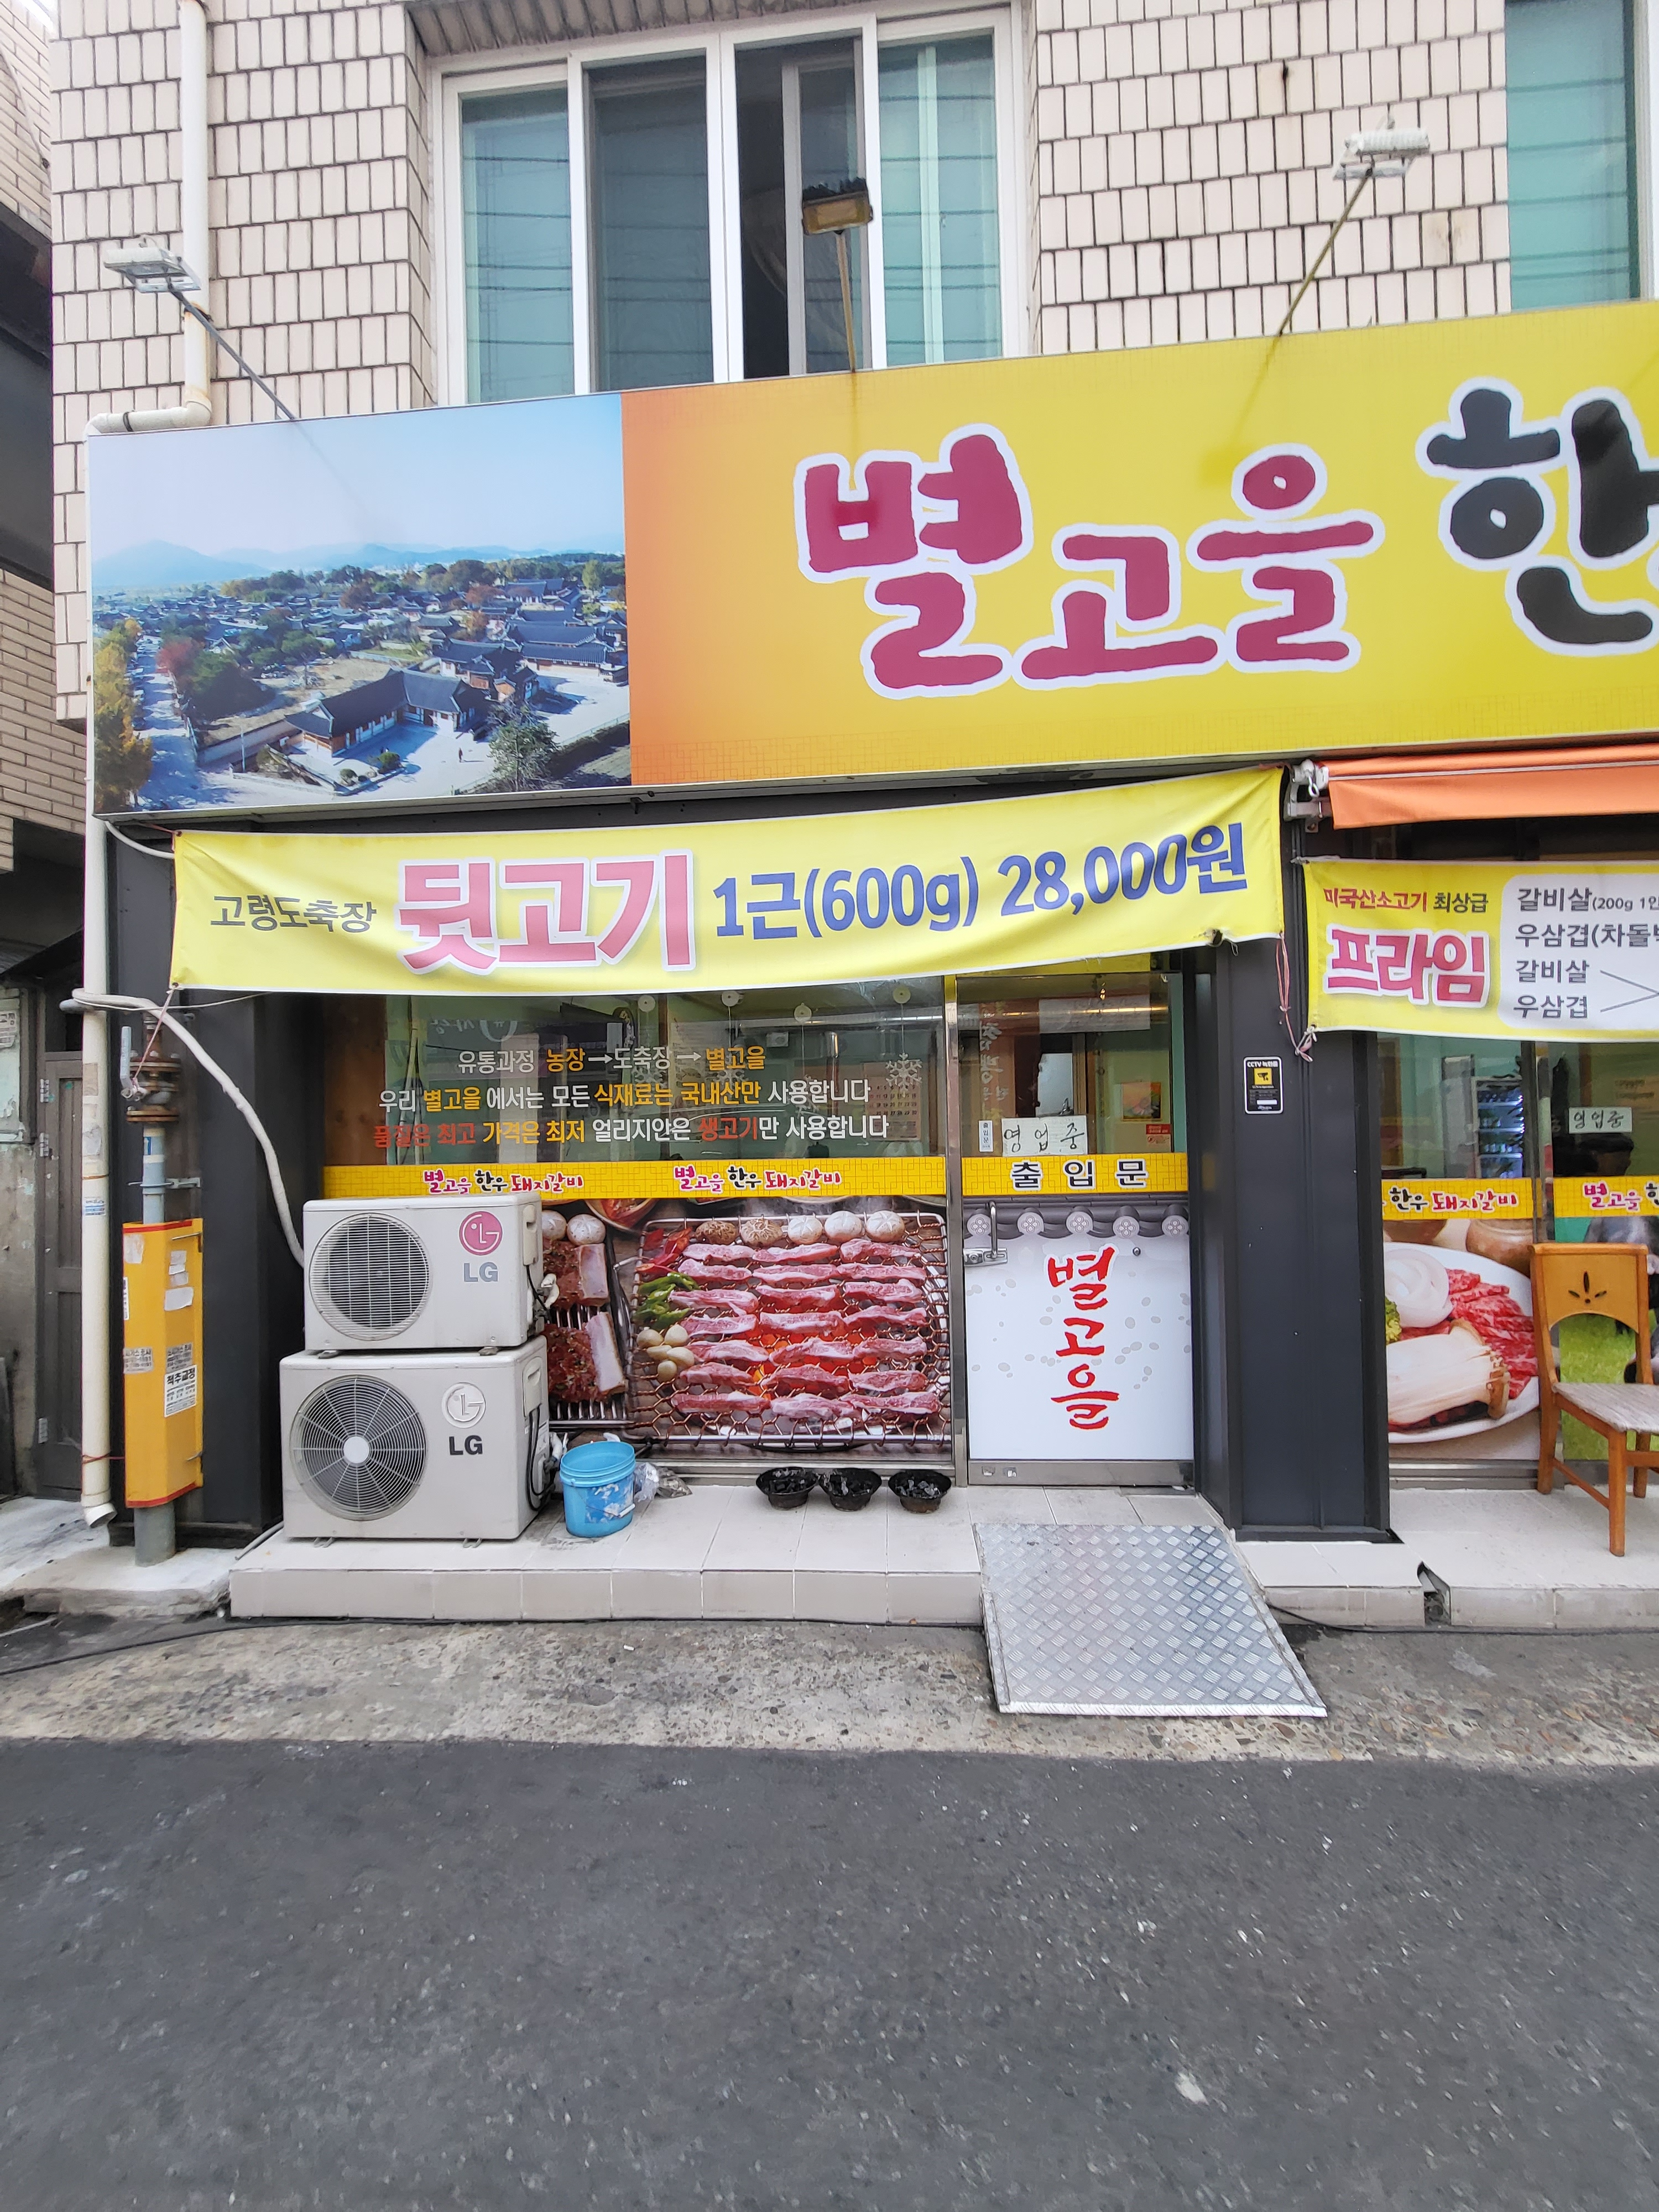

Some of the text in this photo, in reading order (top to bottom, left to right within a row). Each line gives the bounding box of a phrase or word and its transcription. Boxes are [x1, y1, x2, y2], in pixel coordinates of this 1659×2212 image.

[800, 429, 1378, 694] 별고을
[210, 821, 1249, 971] 고령도축장 뒷고기 1근(600g) 28,000원
[1323, 888, 1489, 914] 미국산소고기 최상급
[1515, 923, 1659, 948] 우삼겹(차돌
[1328, 928, 1486, 1003] 프라임
[1515, 959, 1590, 984] 갈비살
[1513, 994, 1589, 1019] 우삼겹
[457, 1045, 766, 1074] 유통과정 농장 도축장 별고을
[378, 1089, 416, 1113] 우리
[423, 1086, 482, 1113] 별고을
[486, 1086, 545, 1110] 에서는
[551, 1084, 591, 1108] 모든
[593, 1082, 674, 1107] 식재료는
[680, 1079, 761, 1107] 국내산만
[767, 1077, 872, 1105] 사용합니다
[373, 1113, 890, 1149] 품질은 최고 가격은 최저 얼리지안은 생고기만 사용합니다
[423, 1168, 584, 1194] 별고을 한우 돼지갈비
[674, 1165, 842, 1193] 별고을 한우 돼지갈비
[1389, 1187, 1517, 1212] 한우 돼지갈비
[1583, 1182, 1641, 1211] 별고을
[463, 1262, 499, 1282] LG
[1047, 1246, 1121, 1430] 별고을
[448, 1434, 483, 1455] LG
